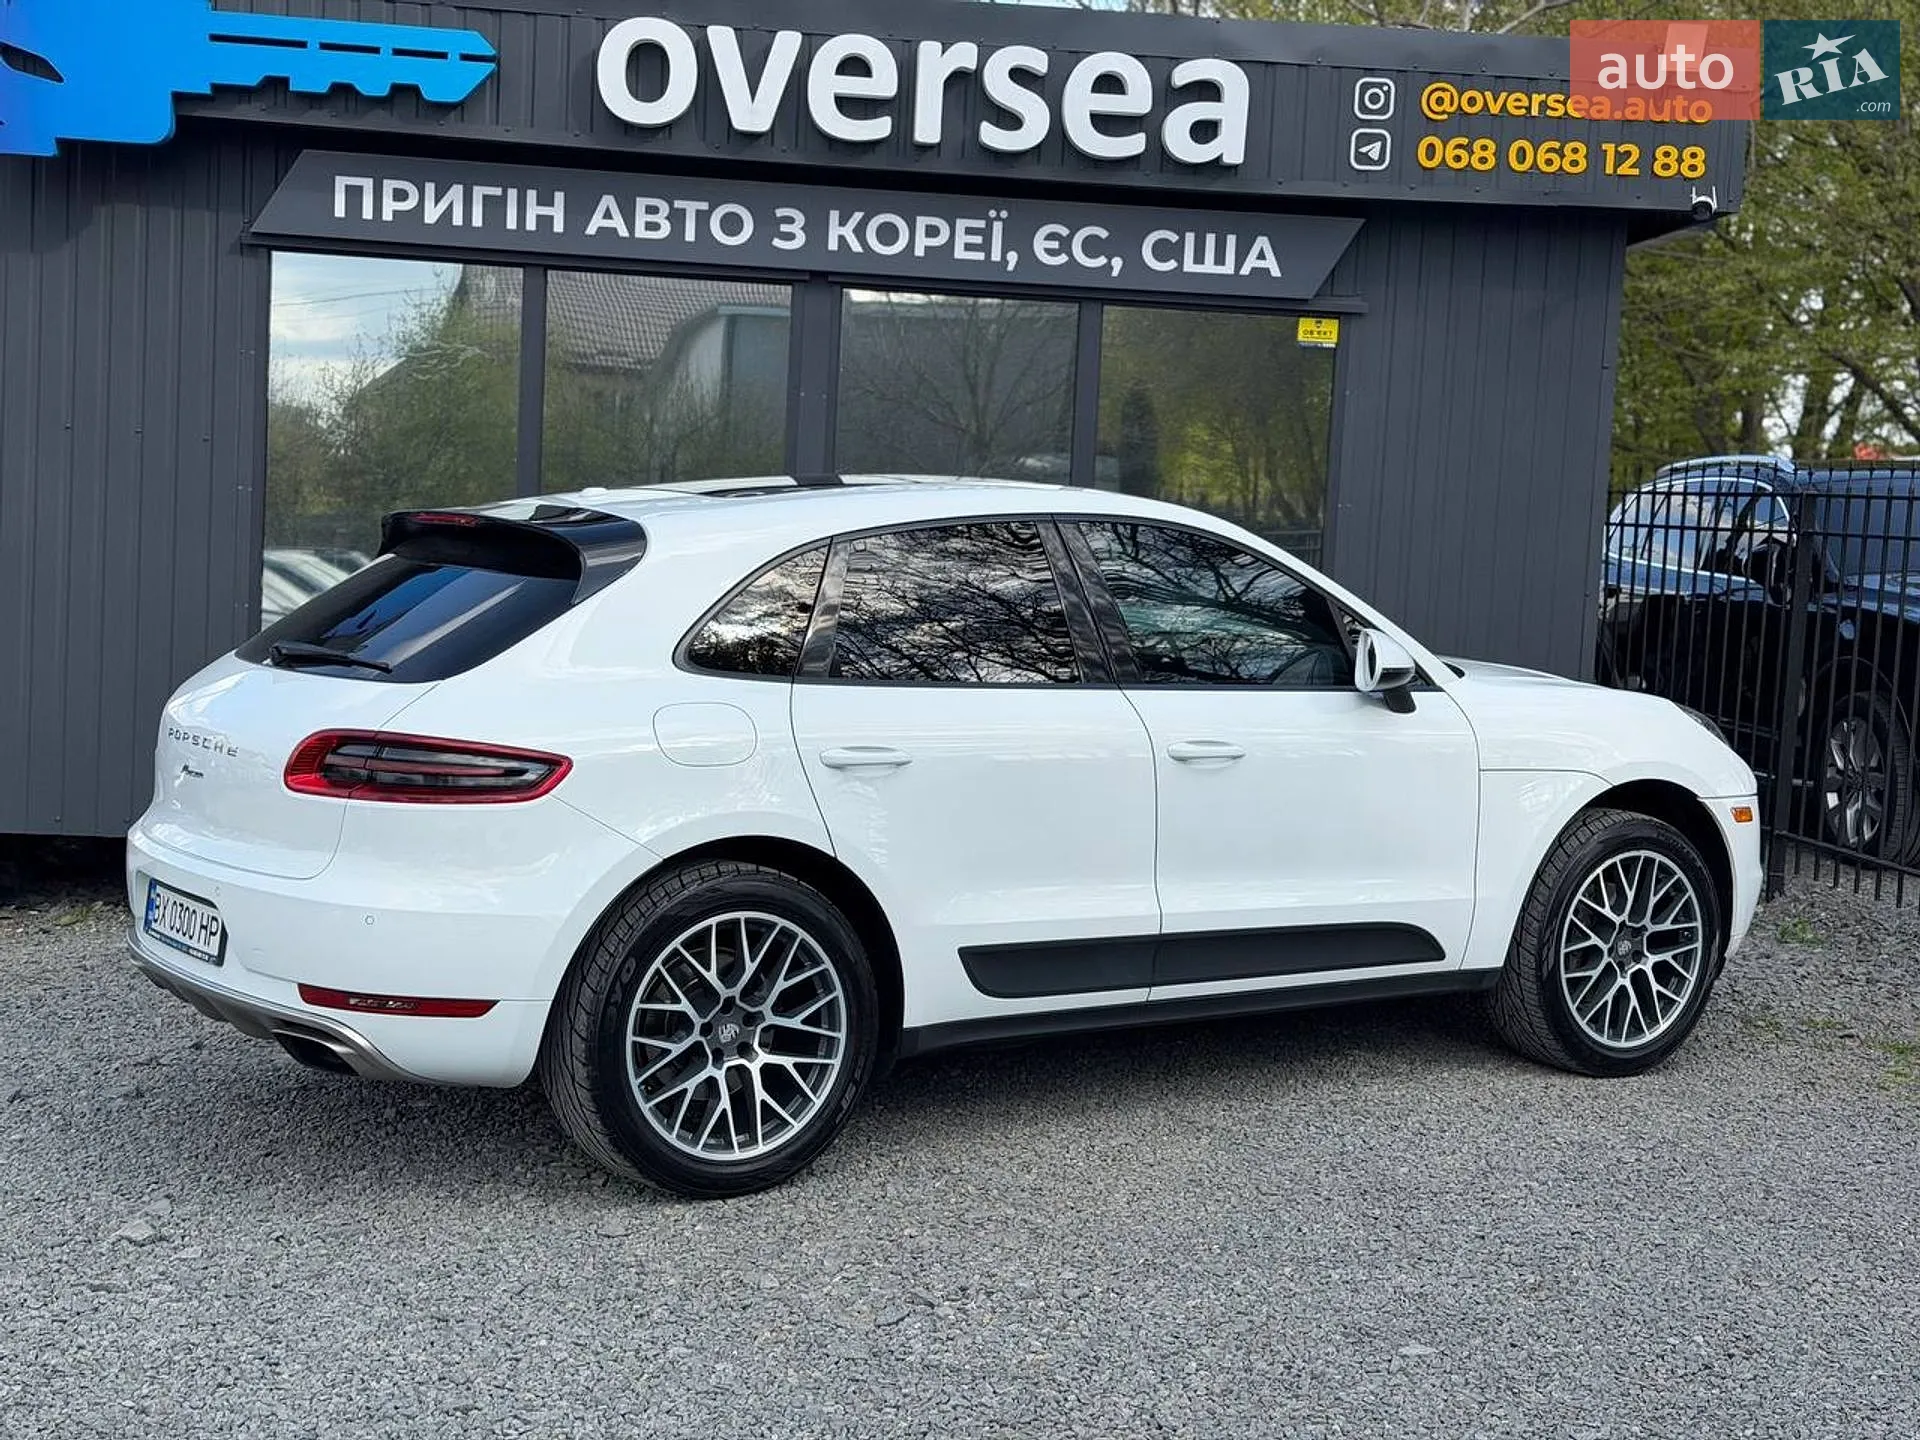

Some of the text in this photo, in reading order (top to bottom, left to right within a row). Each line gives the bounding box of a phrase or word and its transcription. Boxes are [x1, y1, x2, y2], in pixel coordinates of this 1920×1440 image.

[597, 16, 1250, 167] oversea
[1421, 82, 1714, 125] @oversea.auto
[1417, 135, 1707, 179] 068 068 12 88
[333, 174, 566, 234] ПРИГІН
[584, 194, 755, 246] АВТО
[827, 209, 1019, 272] КОРЕЇ,
[1032, 223, 1123, 278] ЄС,
[1140, 230, 1283, 278] США
[169, 900, 198, 940] 0300
